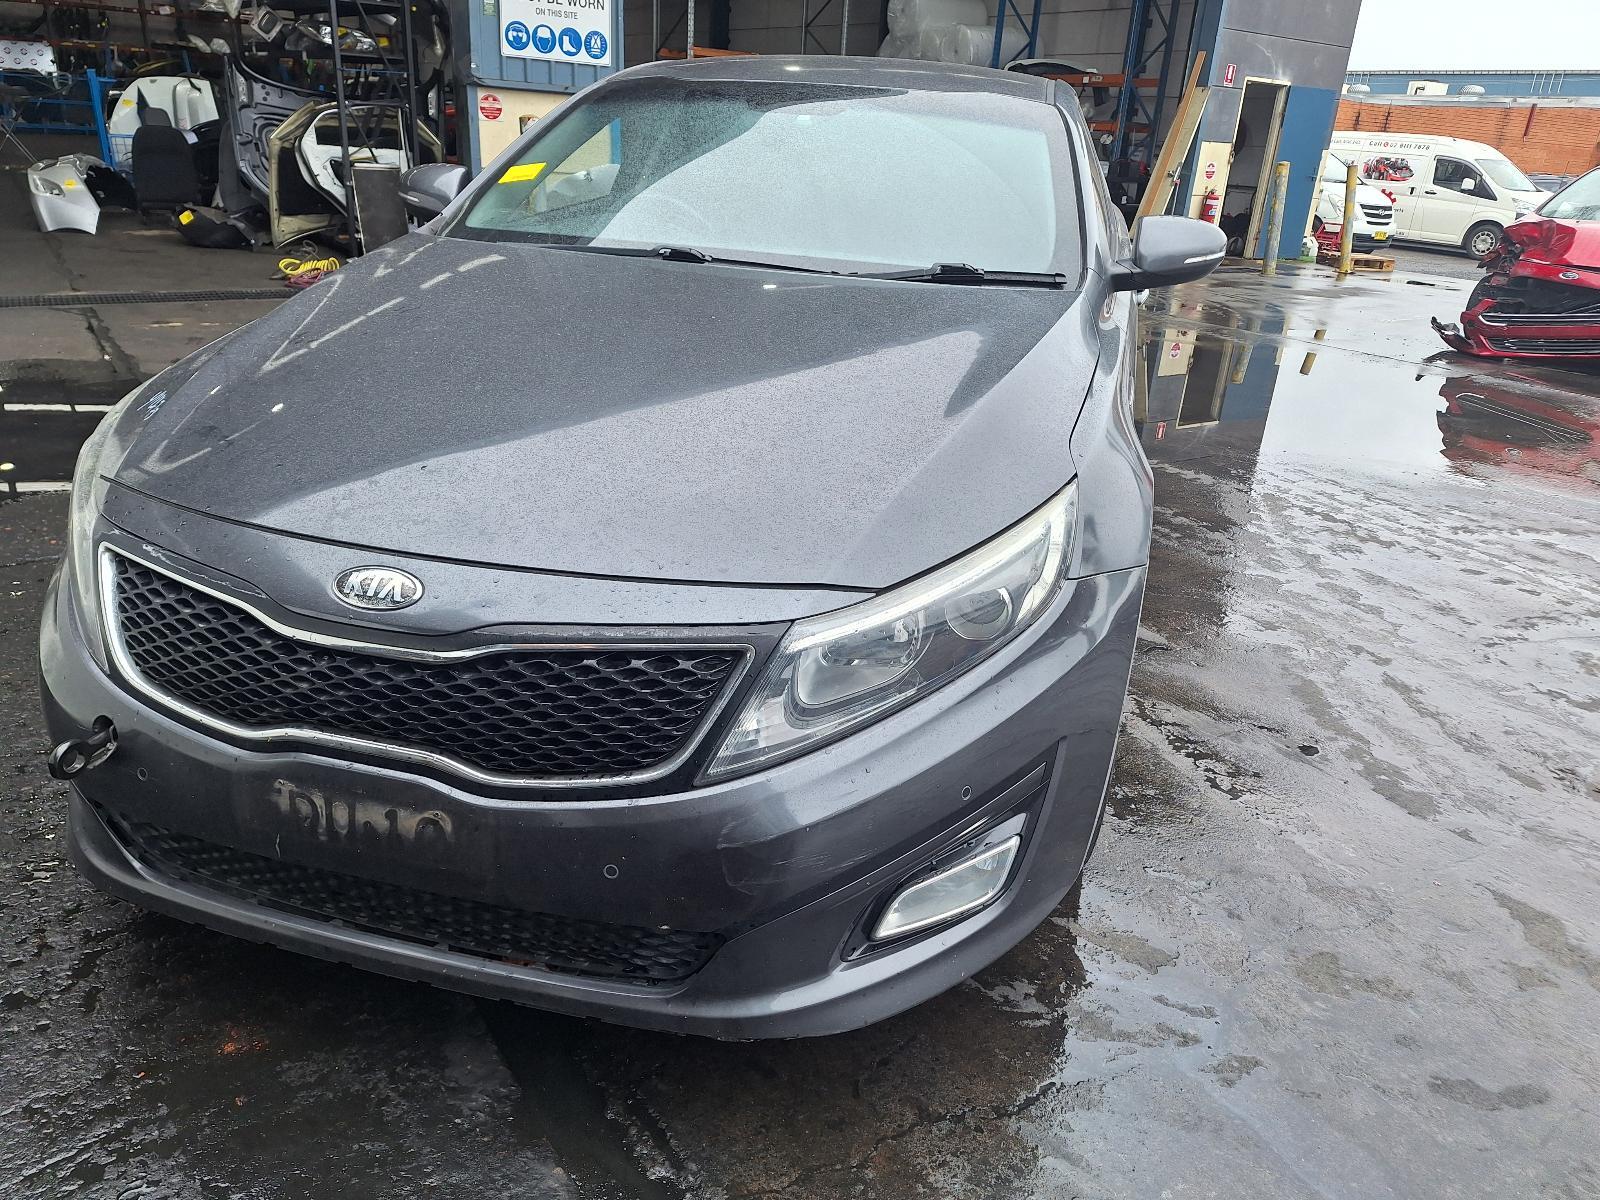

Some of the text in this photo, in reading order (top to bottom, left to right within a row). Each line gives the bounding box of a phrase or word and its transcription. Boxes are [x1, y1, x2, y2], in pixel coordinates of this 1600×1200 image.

[567, 0, 605, 10] WORN
[535, 7, 578, 20] ON THIS SITE
[343, 571, 404, 602] KIA
